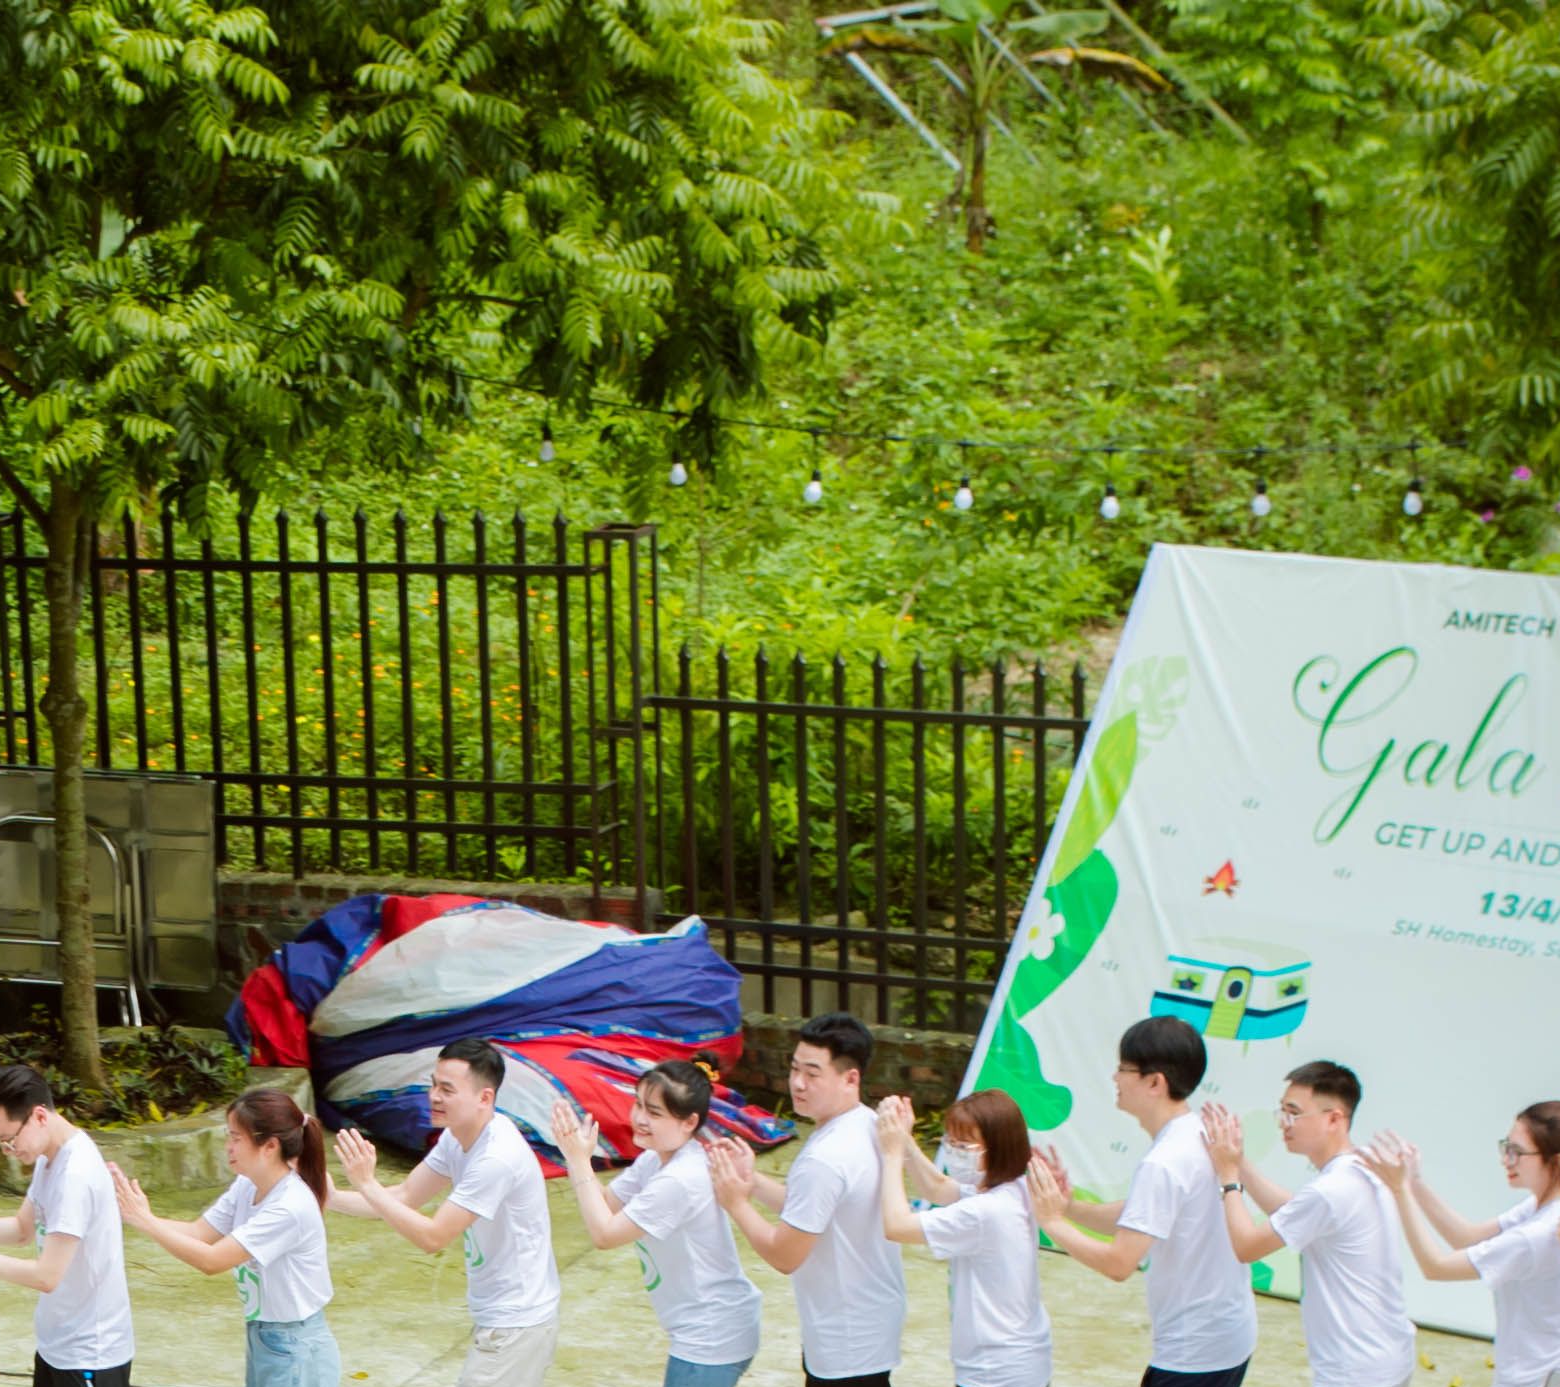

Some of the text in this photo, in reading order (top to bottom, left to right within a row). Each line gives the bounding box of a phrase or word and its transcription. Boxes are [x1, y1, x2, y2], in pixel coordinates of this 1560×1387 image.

[1443, 610, 1557, 639] AMITECH
[1292, 646, 1547, 846] Gala
[1374, 821, 1436, 849] GET
[1442, 830, 1486, 856] UP
[1391, 919, 1422, 938] SH
[1427, 924, 1536, 957] Homestay,
